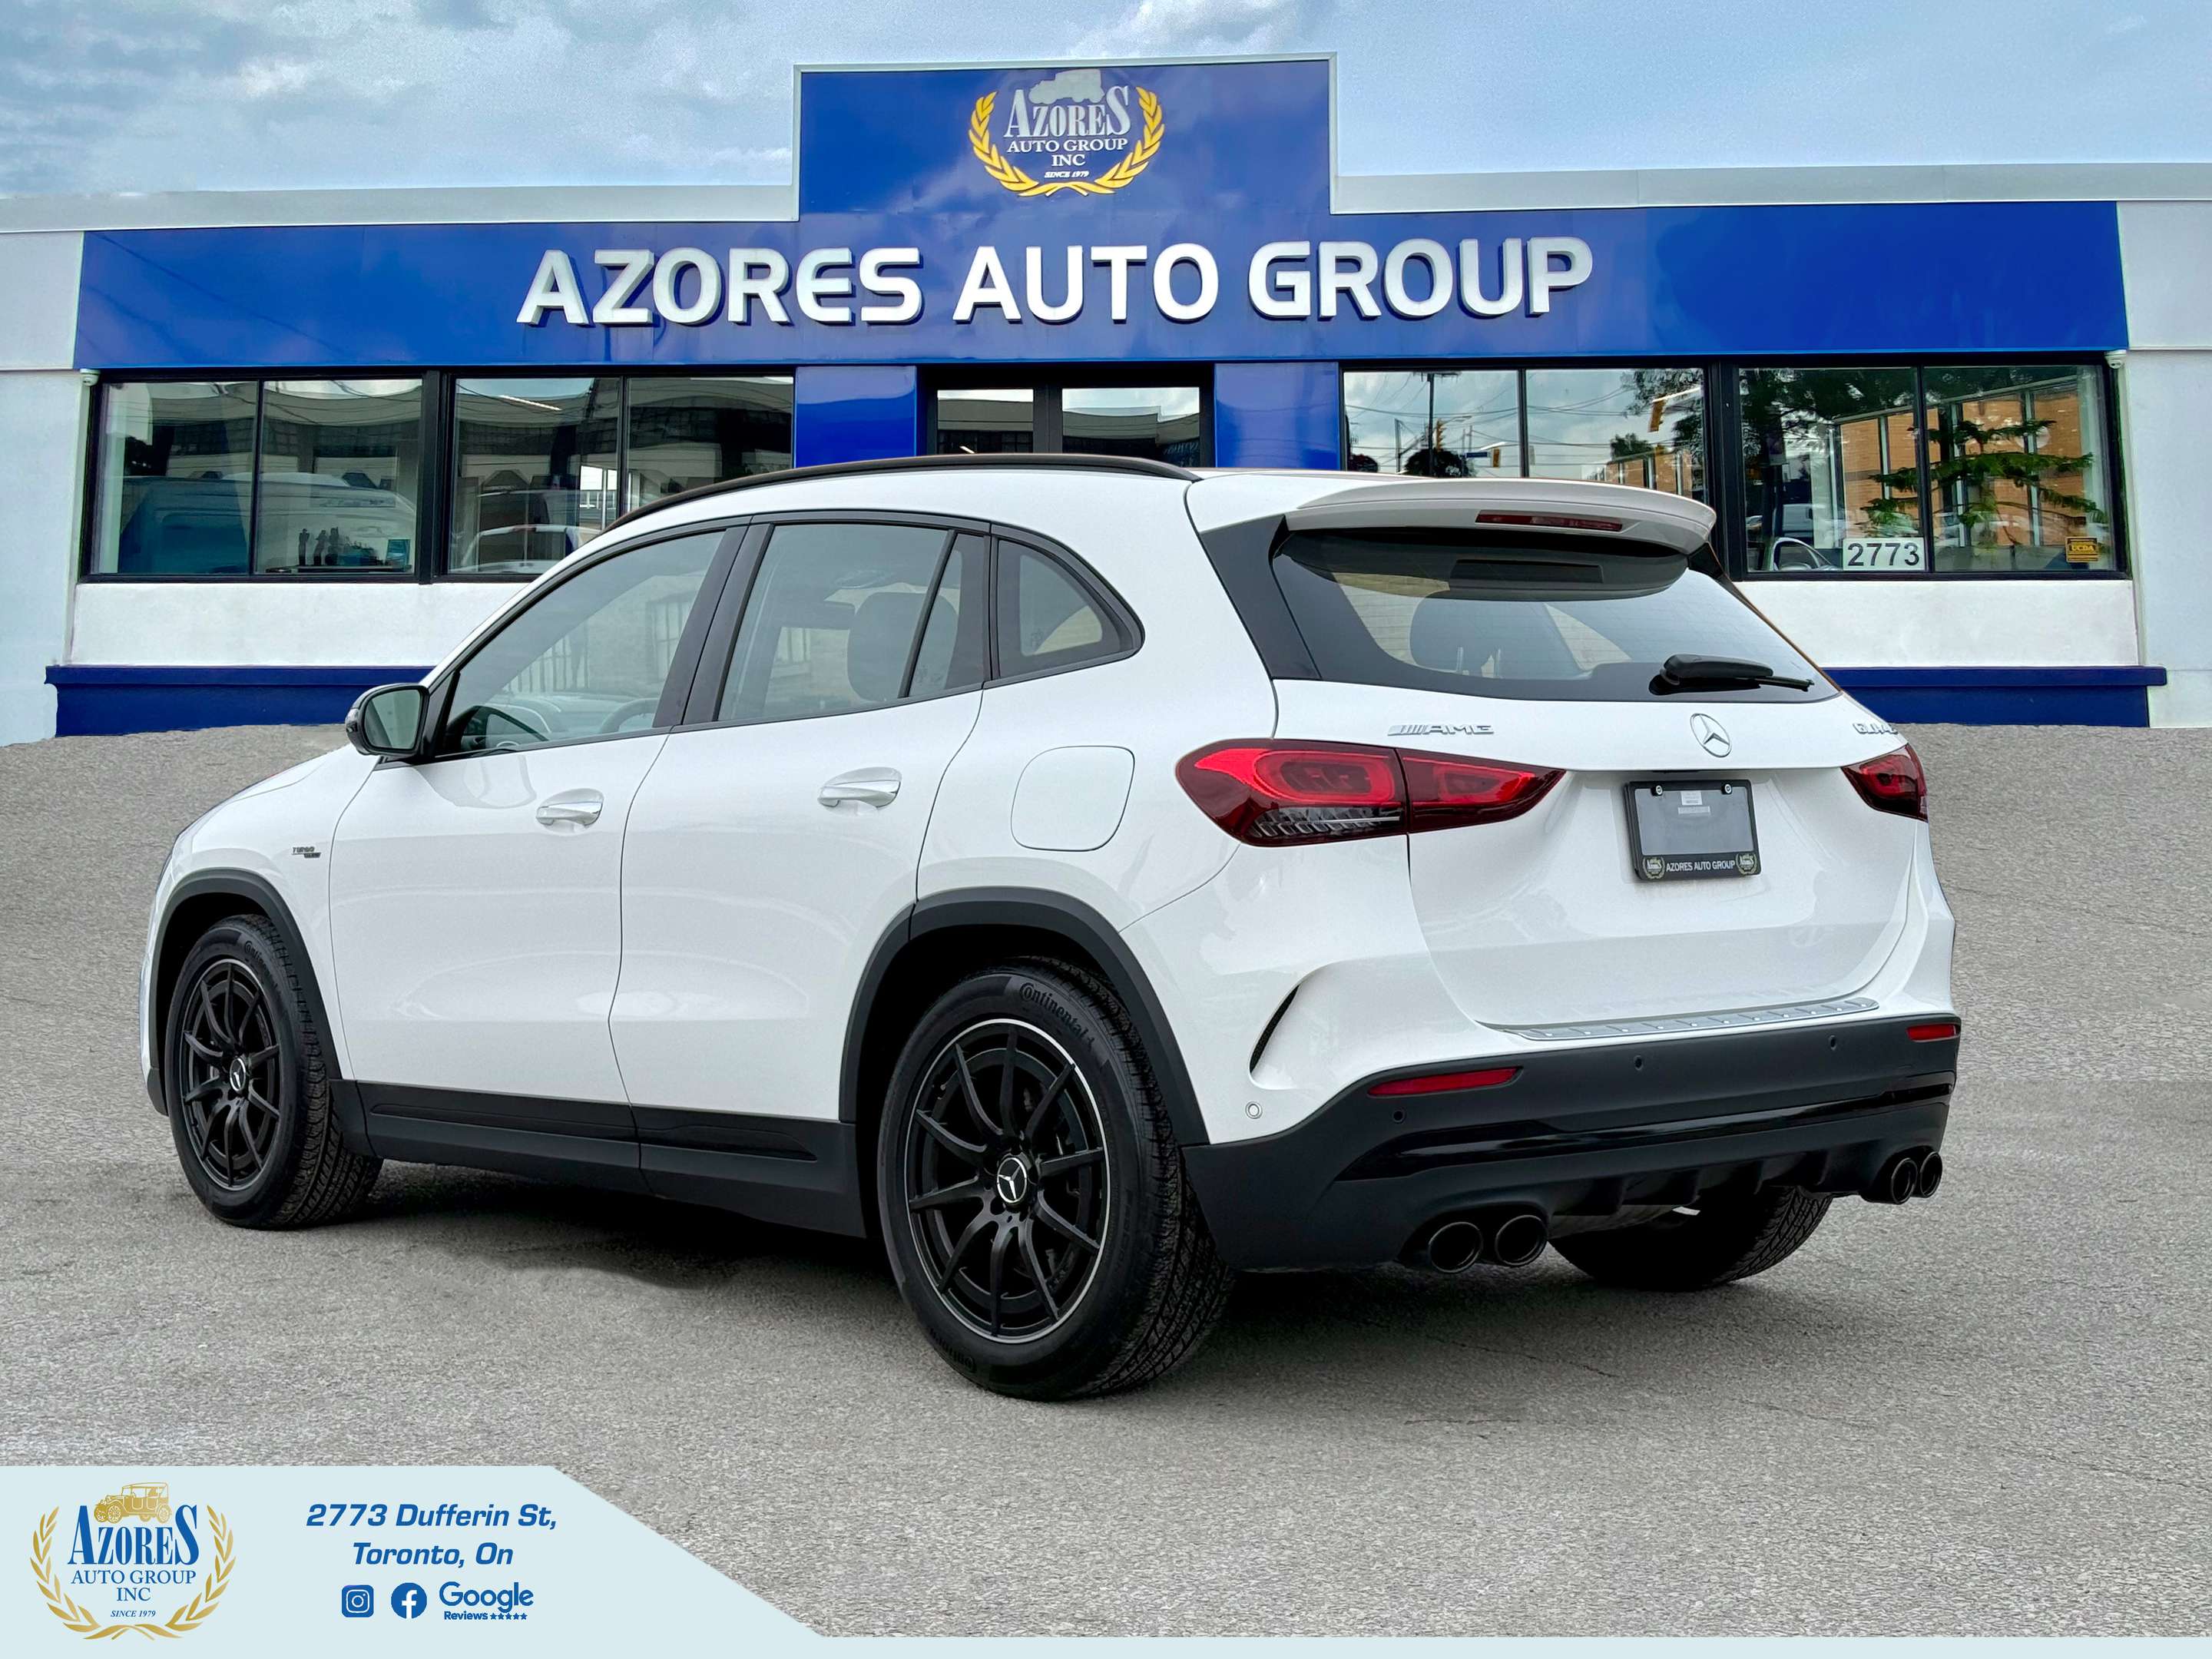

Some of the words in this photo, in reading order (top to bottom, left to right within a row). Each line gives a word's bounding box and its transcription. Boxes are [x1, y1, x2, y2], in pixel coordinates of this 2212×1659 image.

[1003, 85, 1131, 138] AZORES
[1007, 140, 1061, 154] AUTO
[1064, 138, 1128, 152] GROUP
[1051, 154, 1086, 167] INC
[516, 247, 922, 326] AZORES
[952, 243, 1220, 325] AUTO
[1248, 237, 1594, 320] GROUP
[1846, 542, 1920, 568] 2773
[1422, 725, 1495, 735] AMG
[1666, 862, 1694, 872] AZORES
[1694, 861, 1711, 870] AUTO
[1712, 860, 1736, 869] GROUP
[1019, 982, 1089, 1038] Continental
